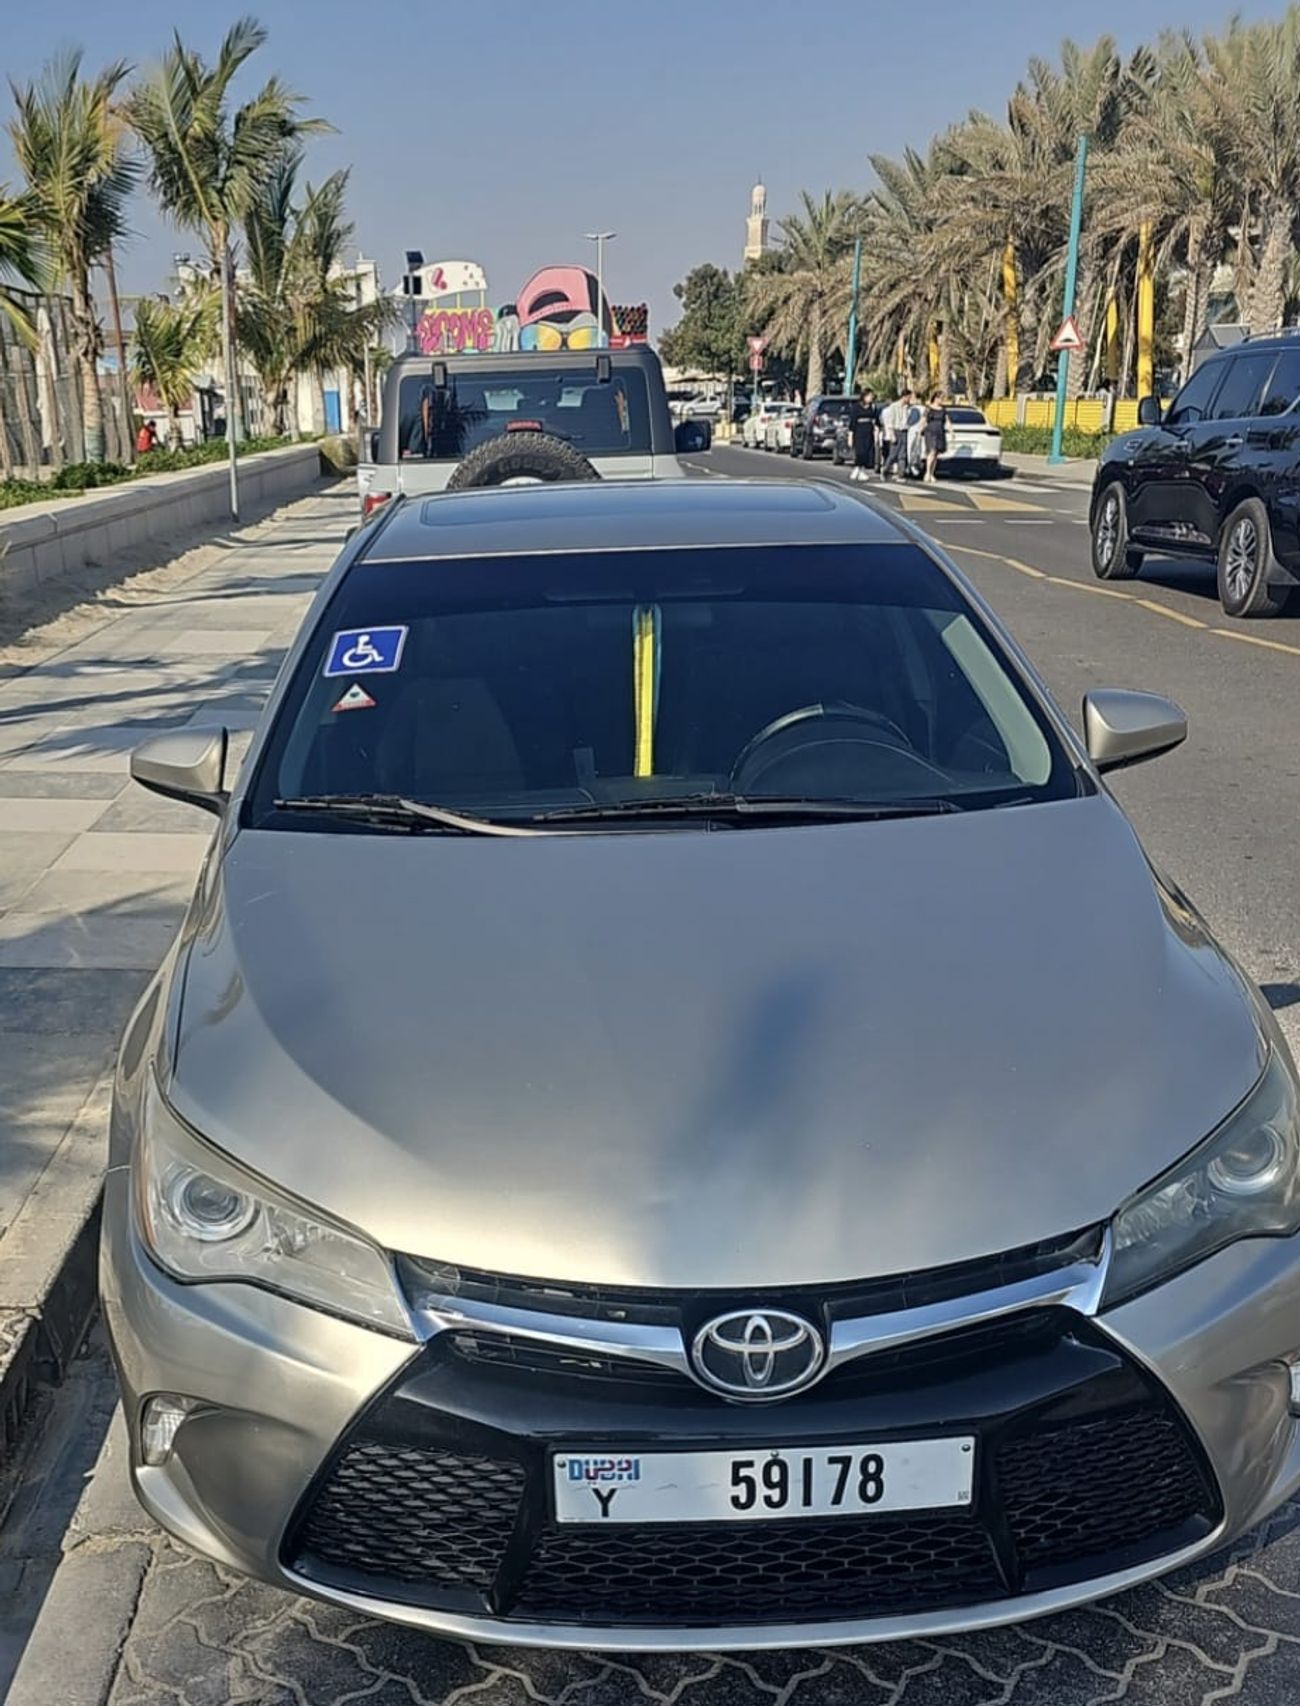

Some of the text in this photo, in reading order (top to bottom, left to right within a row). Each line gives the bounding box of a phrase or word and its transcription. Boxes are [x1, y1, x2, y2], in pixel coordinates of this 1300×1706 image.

[568, 1459, 640, 1481] DUBAI
[730, 1453, 884, 1511] 59178
[592, 1488, 618, 1518] Y
